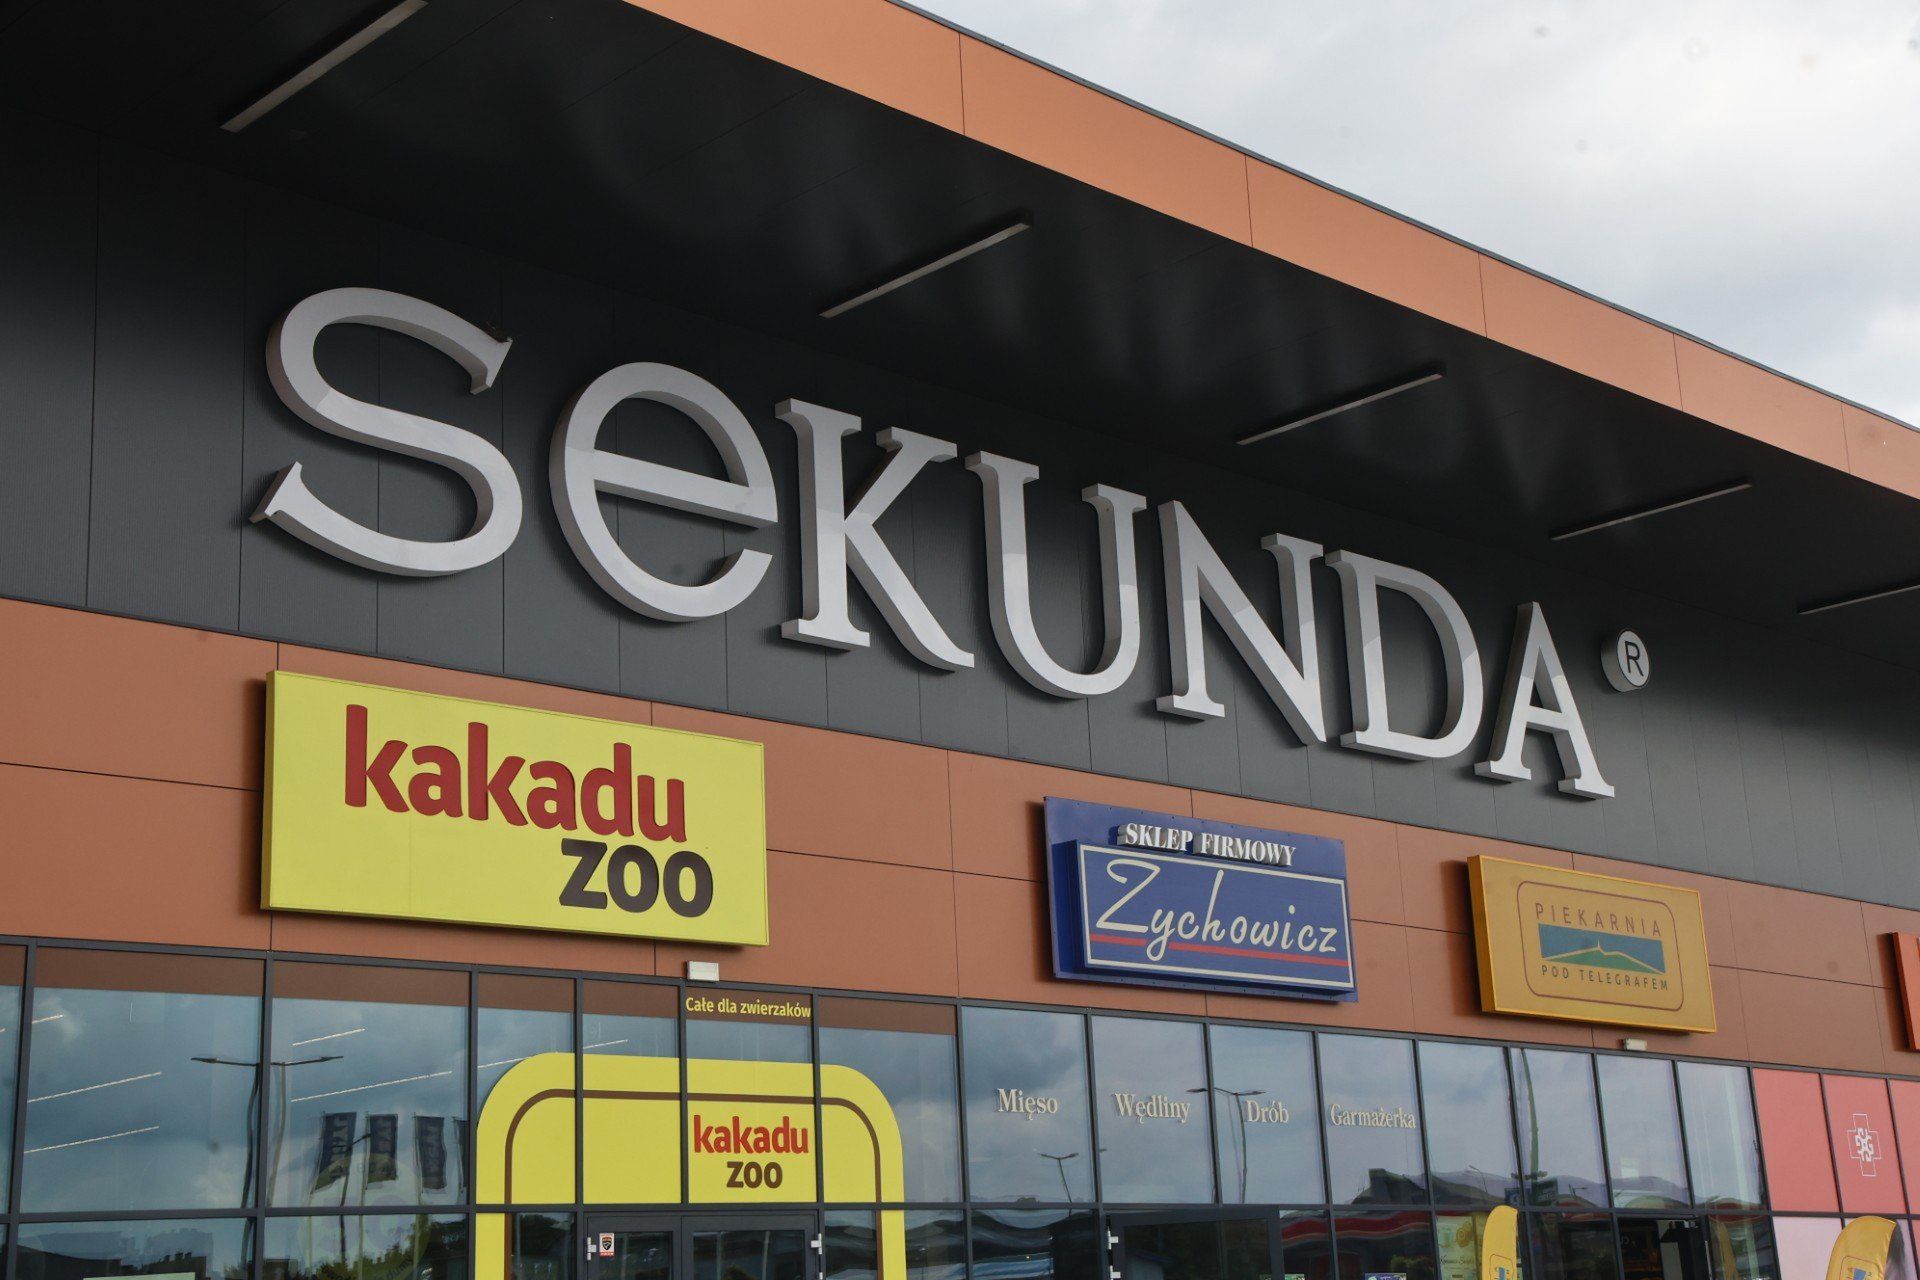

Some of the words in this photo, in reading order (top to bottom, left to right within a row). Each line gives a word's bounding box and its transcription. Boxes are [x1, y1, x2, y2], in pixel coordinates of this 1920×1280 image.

[344, 704, 688, 842] kakadu
[1123, 823, 1193, 852] SKLEP
[1198, 832, 1297, 867] FIRMOWY
[1096, 858, 1339, 962] Zychowicz
[1535, 902, 1662, 937] PIEKARNIA
[1541, 964, 1570, 980] POD
[1578, 968, 1669, 991] TELEGRAFEM
[685, 997, 714, 1012] Całe
[717, 998, 737, 1013] dla
[740, 999, 811, 1018] zwierzaków
[996, 1088, 1059, 1121] Mięso
[1114, 1093, 1191, 1124] Wędliny
[1245, 1099, 1290, 1124] Drób
[1330, 1103, 1417, 1129] Garmażerka
[693, 1114, 809, 1154] kakadu
